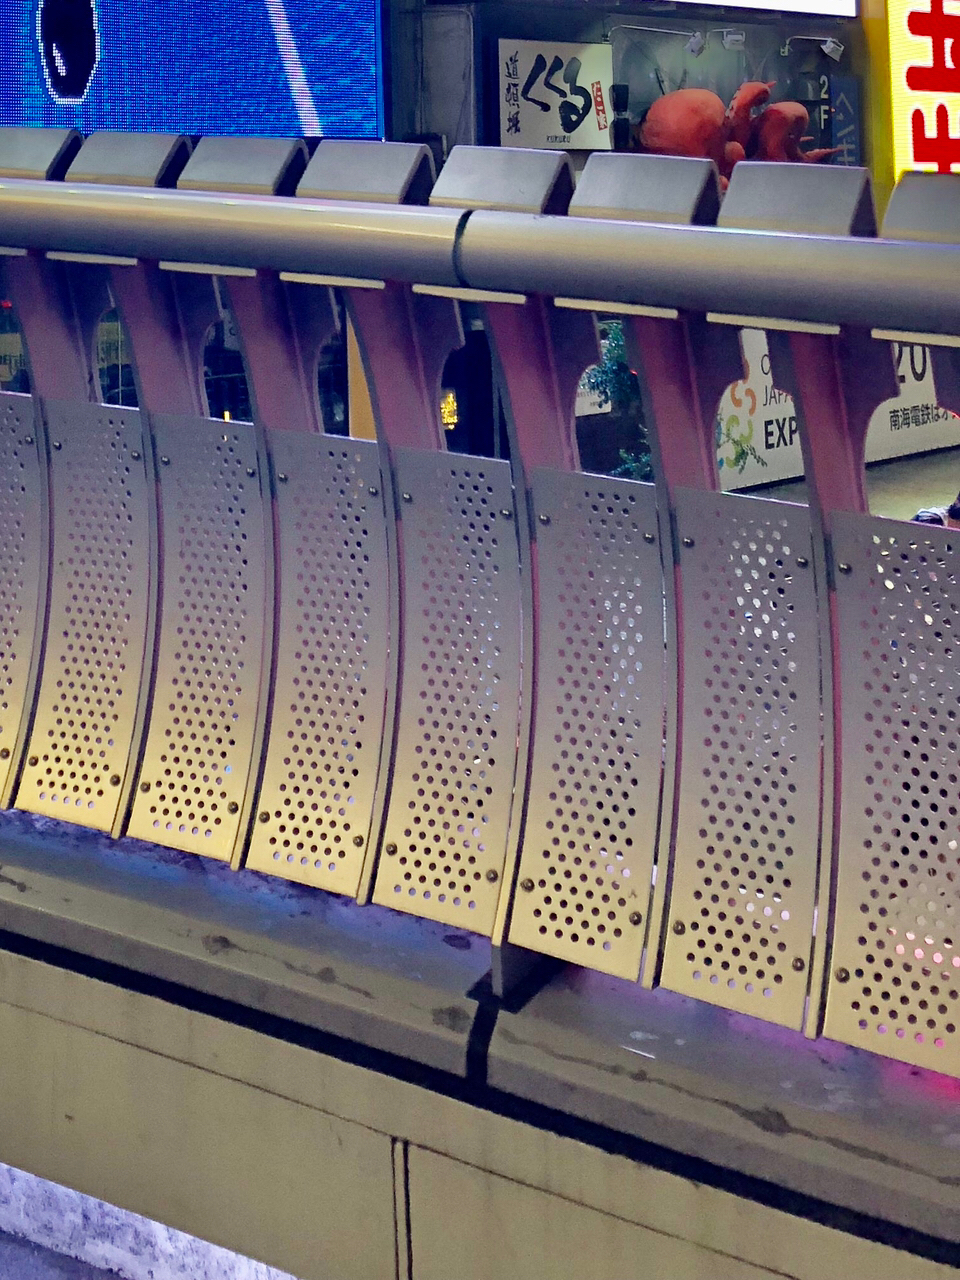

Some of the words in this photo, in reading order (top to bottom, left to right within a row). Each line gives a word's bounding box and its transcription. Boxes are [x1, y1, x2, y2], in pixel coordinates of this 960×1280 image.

[520, 53, 593, 134] くくる
[763, 416, 799, 450] EXP
